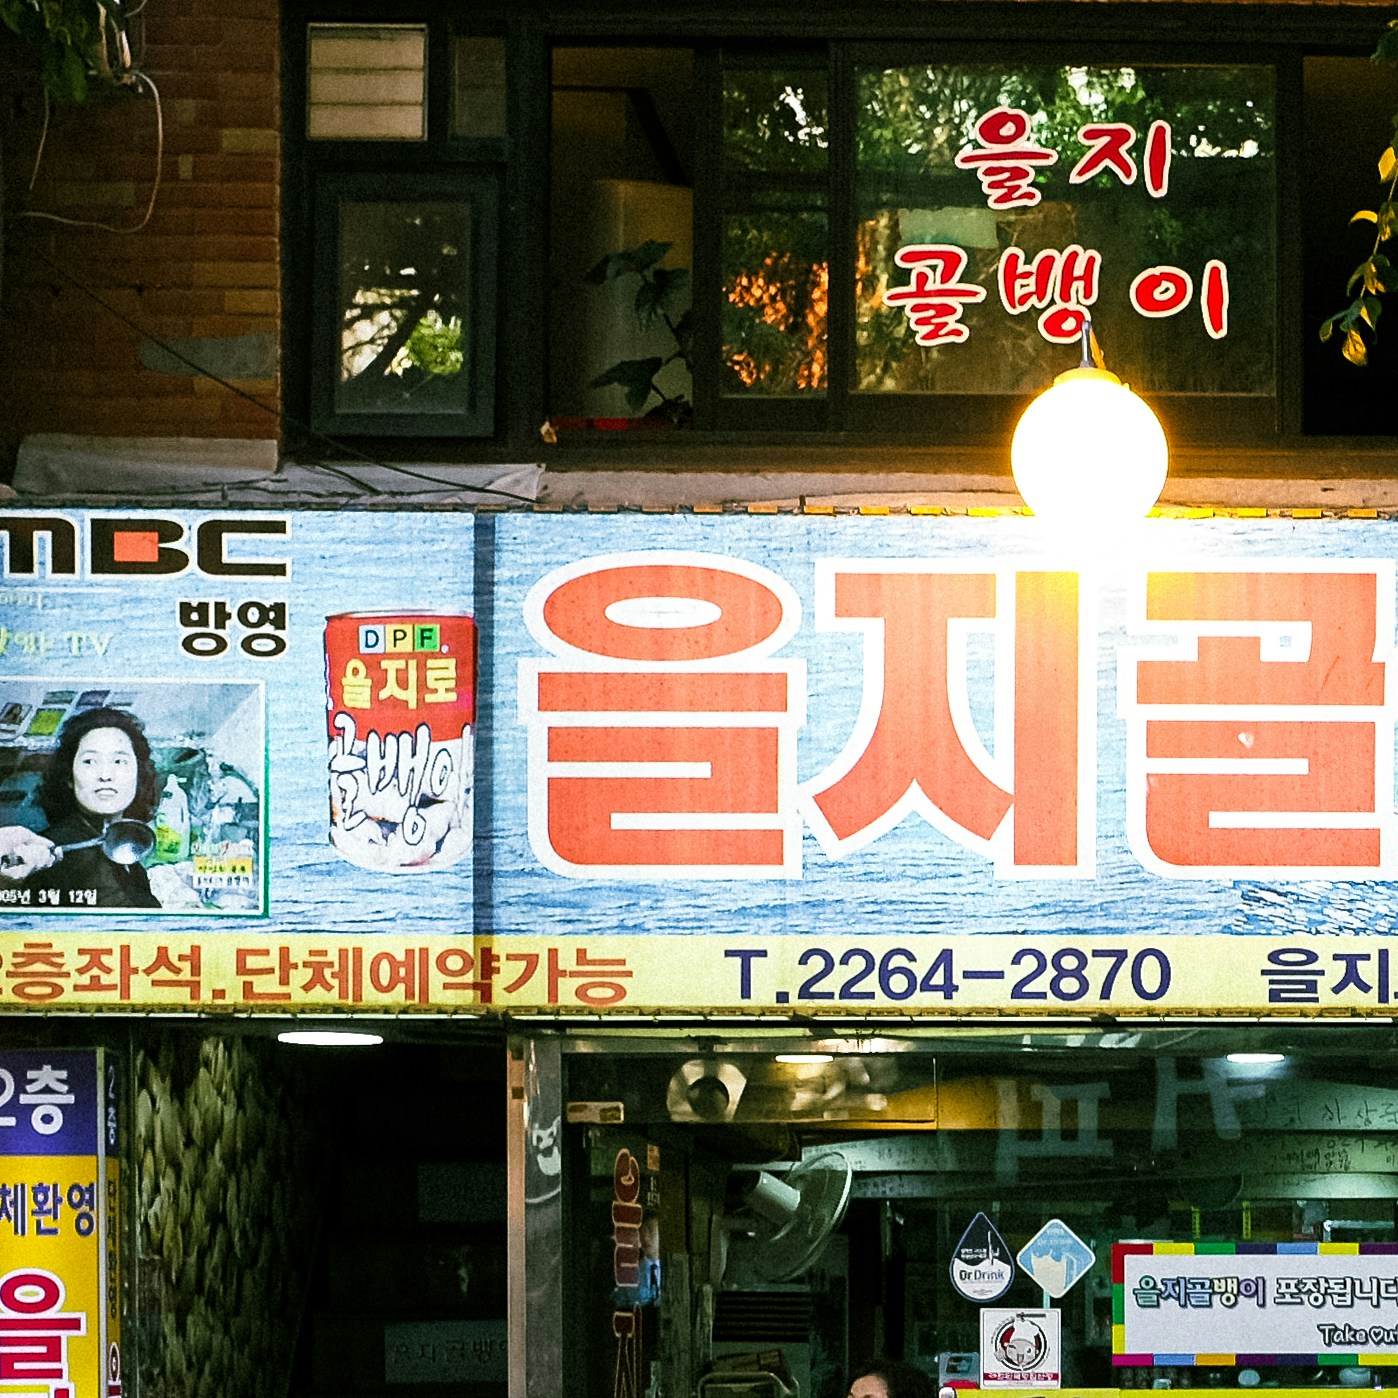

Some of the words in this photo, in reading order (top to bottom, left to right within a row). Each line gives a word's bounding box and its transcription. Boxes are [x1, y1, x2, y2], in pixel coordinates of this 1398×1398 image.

[955, 108, 1172, 210] 을지
[883, 244, 1230, 348] 골뱅이
[178, 600, 288, 658] 방영
[340, 658, 458, 709] 을지로
[722, 945, 1174, 1004] T.2264-2870
[1132, 1274, 1267, 1307] 을지골뱅이
[1317, 1324, 1366, 1346] Take
